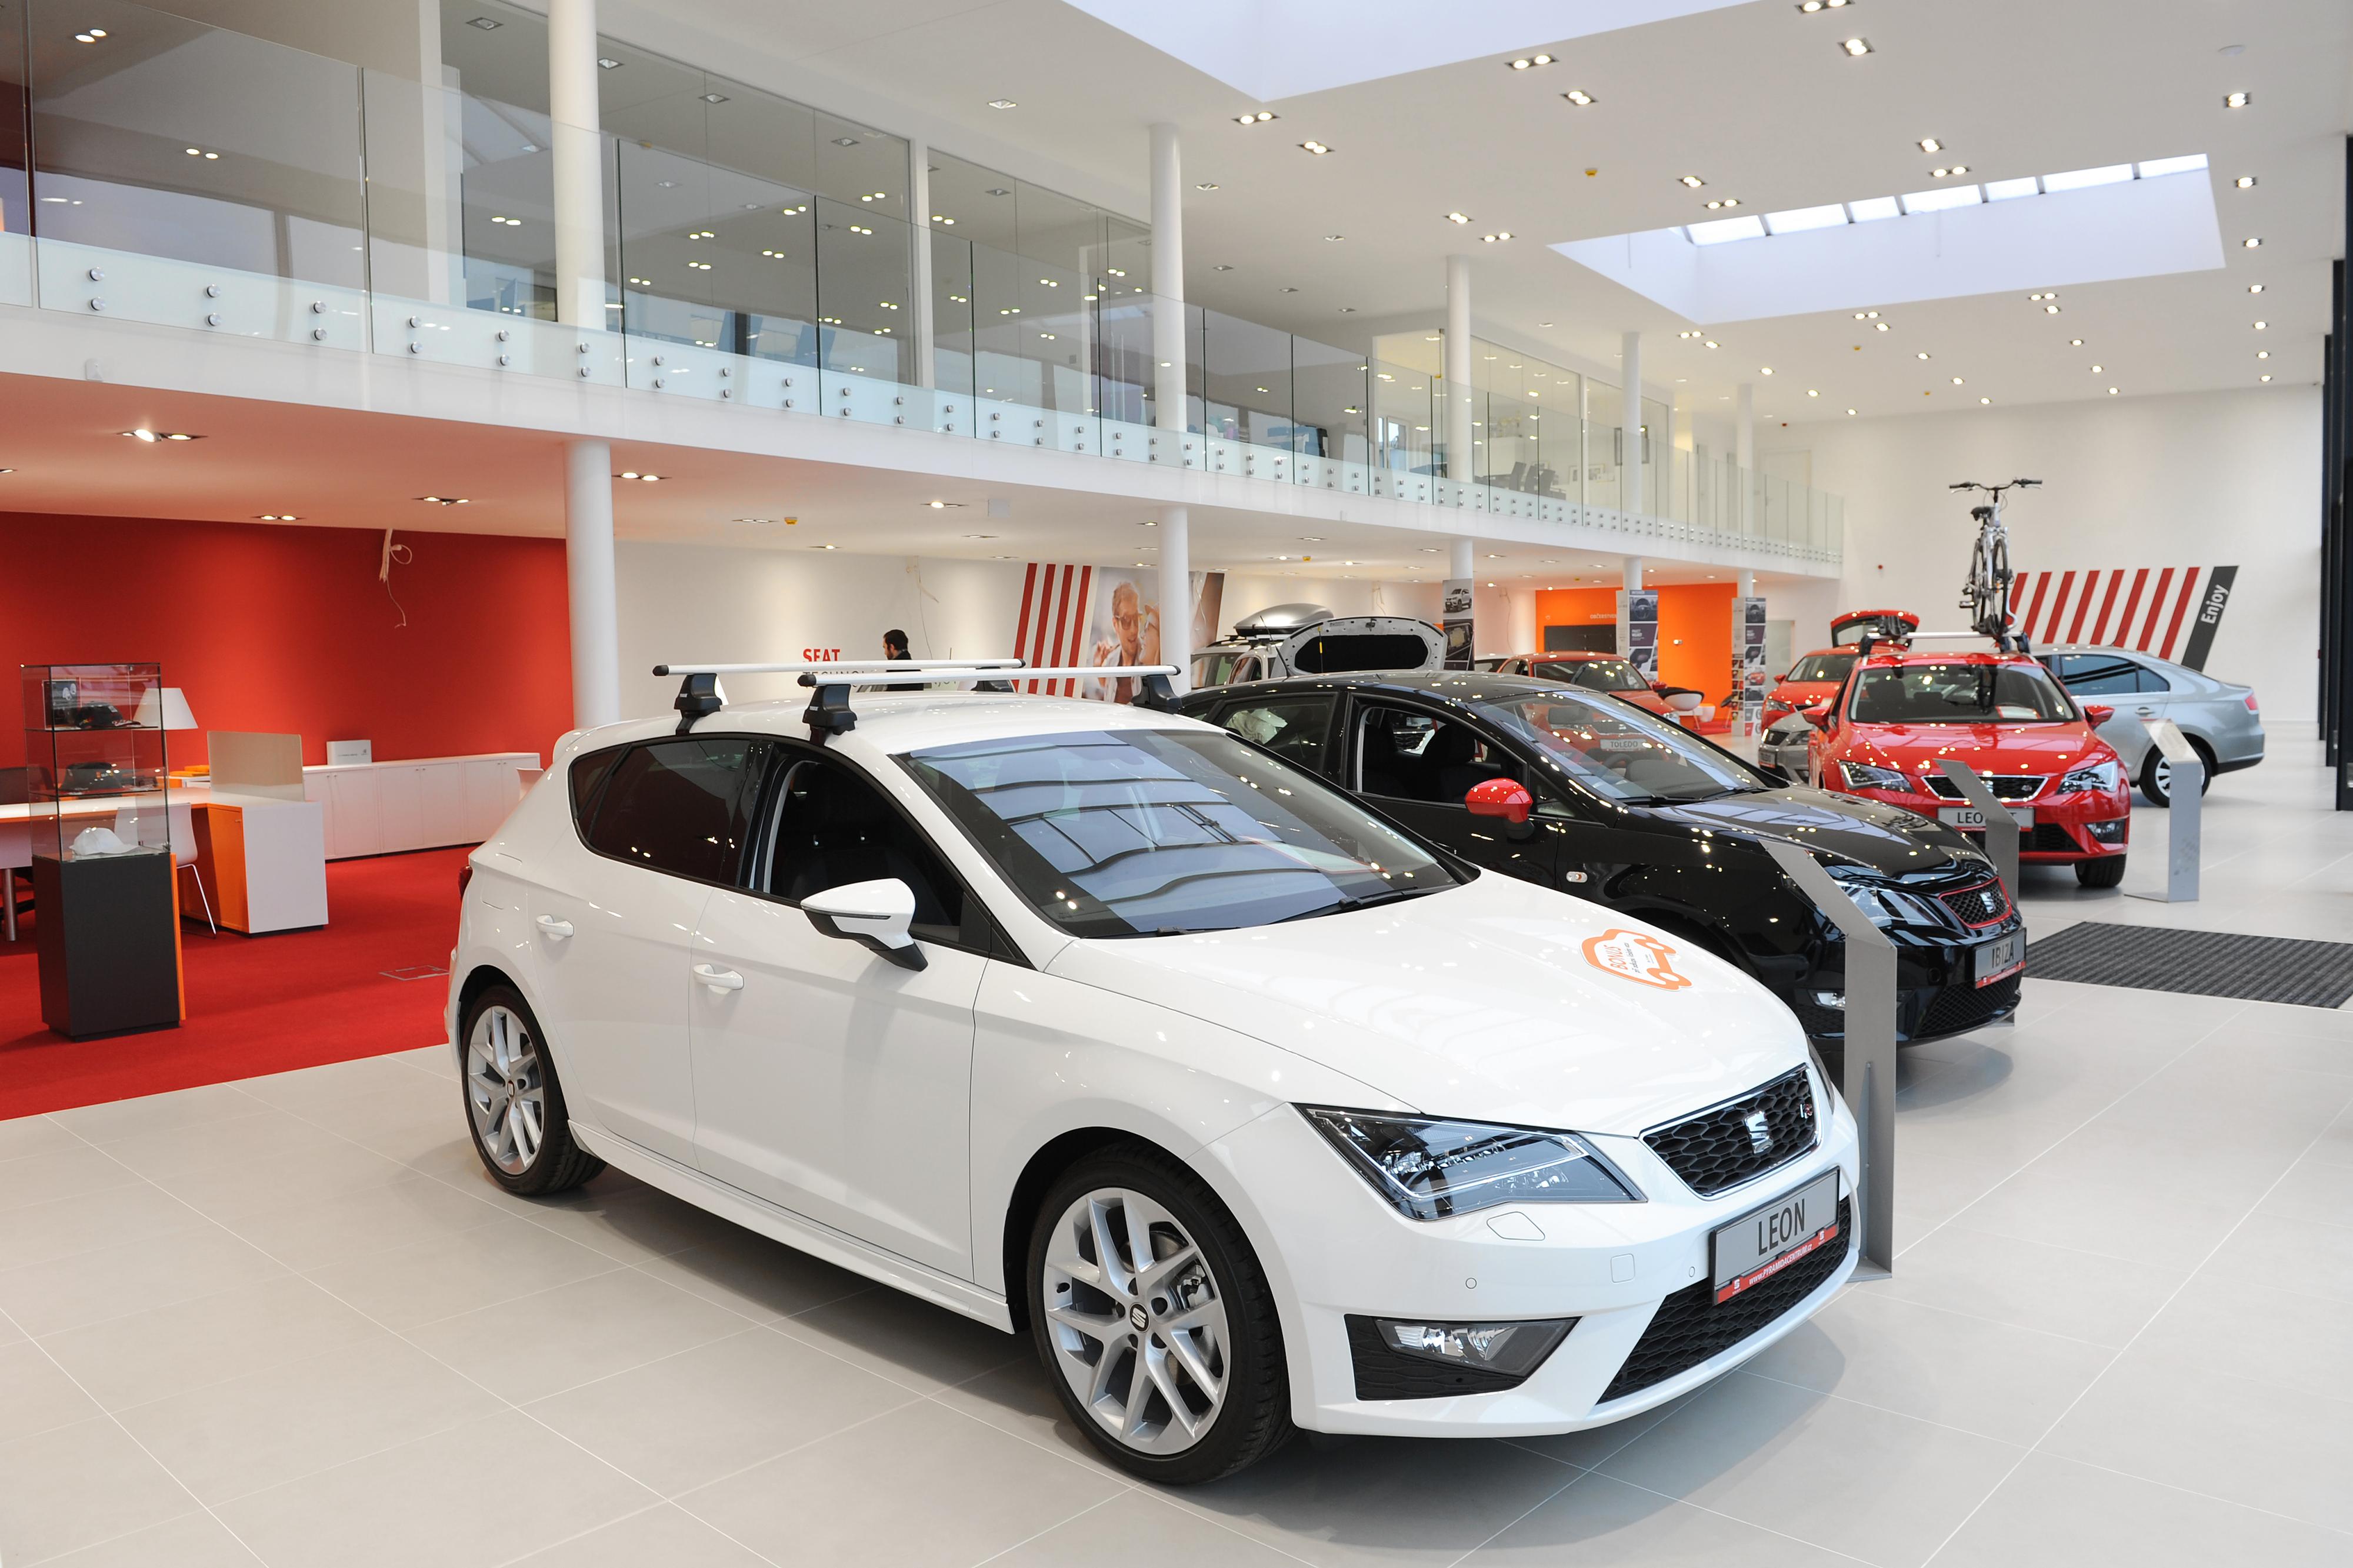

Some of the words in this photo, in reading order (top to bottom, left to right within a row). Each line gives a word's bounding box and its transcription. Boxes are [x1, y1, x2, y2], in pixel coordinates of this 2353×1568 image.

[2201, 584, 2229, 624] Enjoy
[803, 649, 841, 662] SEAT
[1957, 812, 1983, 823] LEO
[1992, 942, 2014, 968] IBIZA
[1758, 1198, 1805, 1256] LEON
